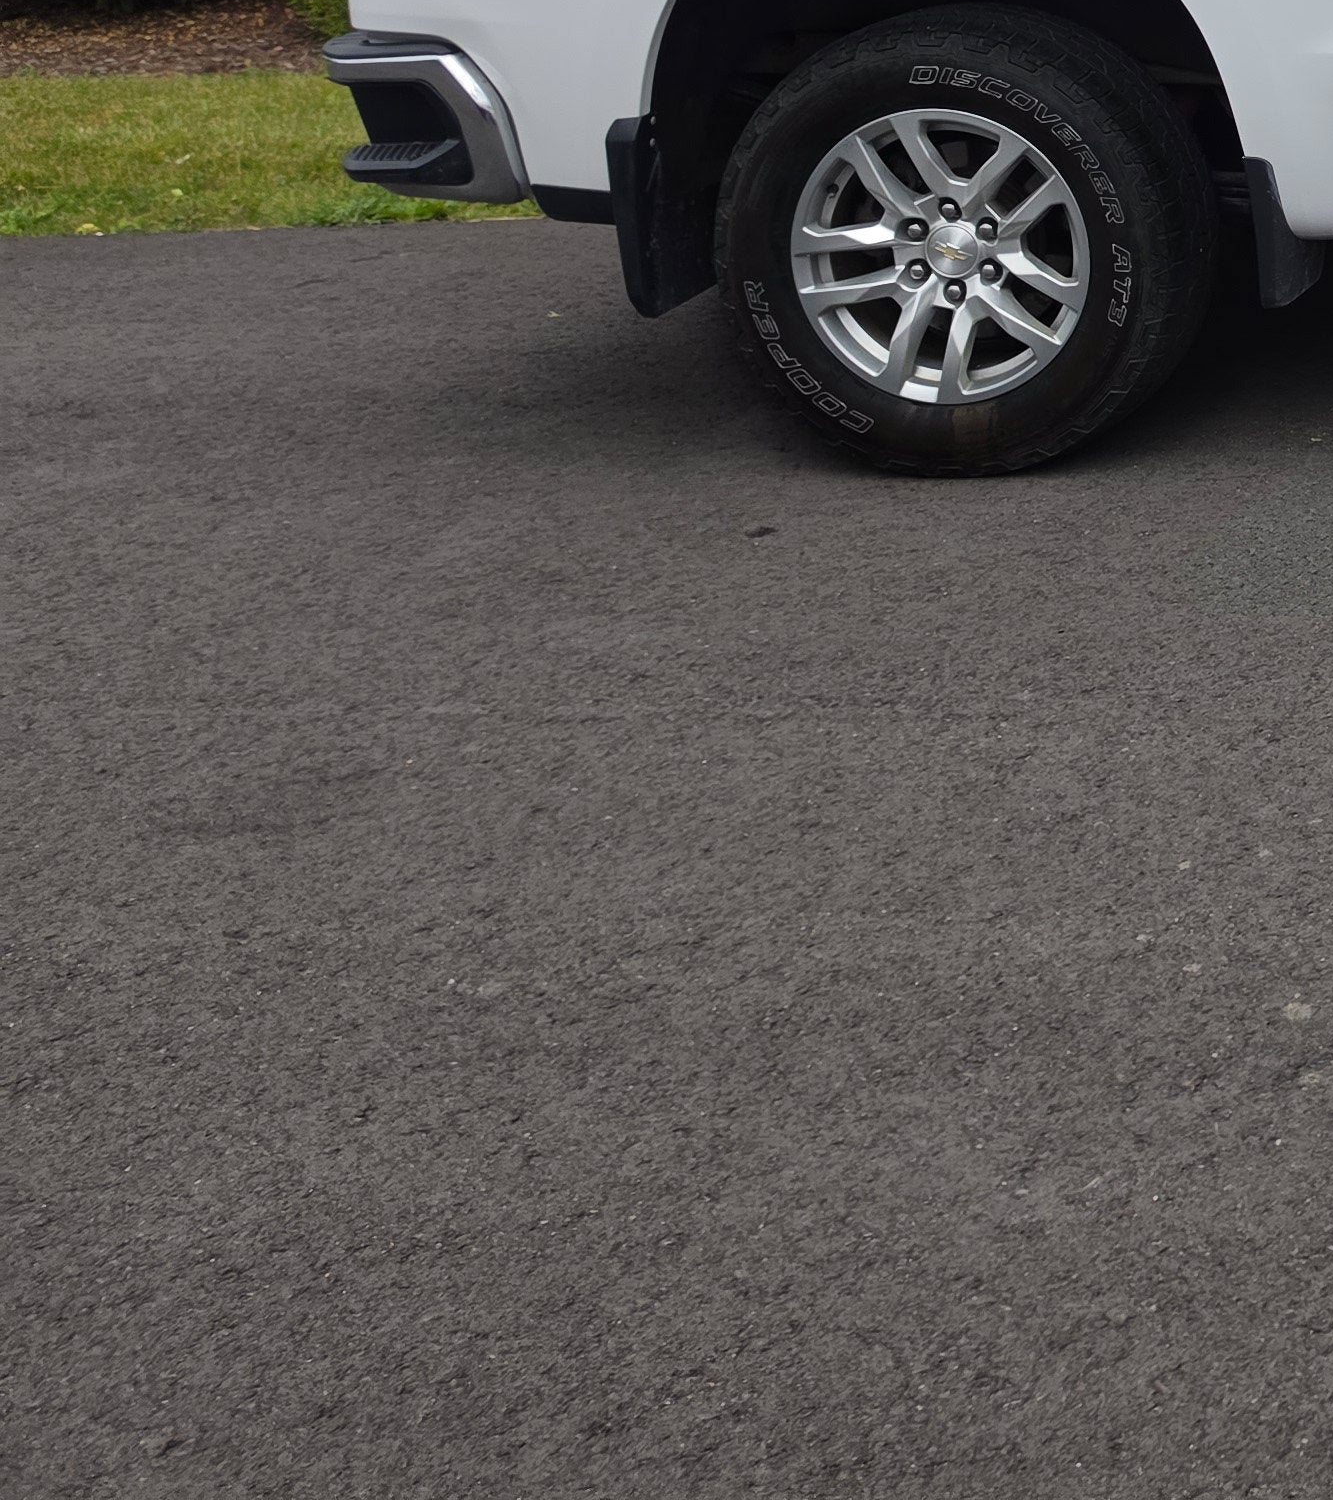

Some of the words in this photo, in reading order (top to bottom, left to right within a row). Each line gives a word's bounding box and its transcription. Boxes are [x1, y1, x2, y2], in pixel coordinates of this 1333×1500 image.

[908, 65, 1124, 226] DISCOVERER
[1107, 243, 1133, 327] AT3
[742, 280, 875, 434] COOPER
